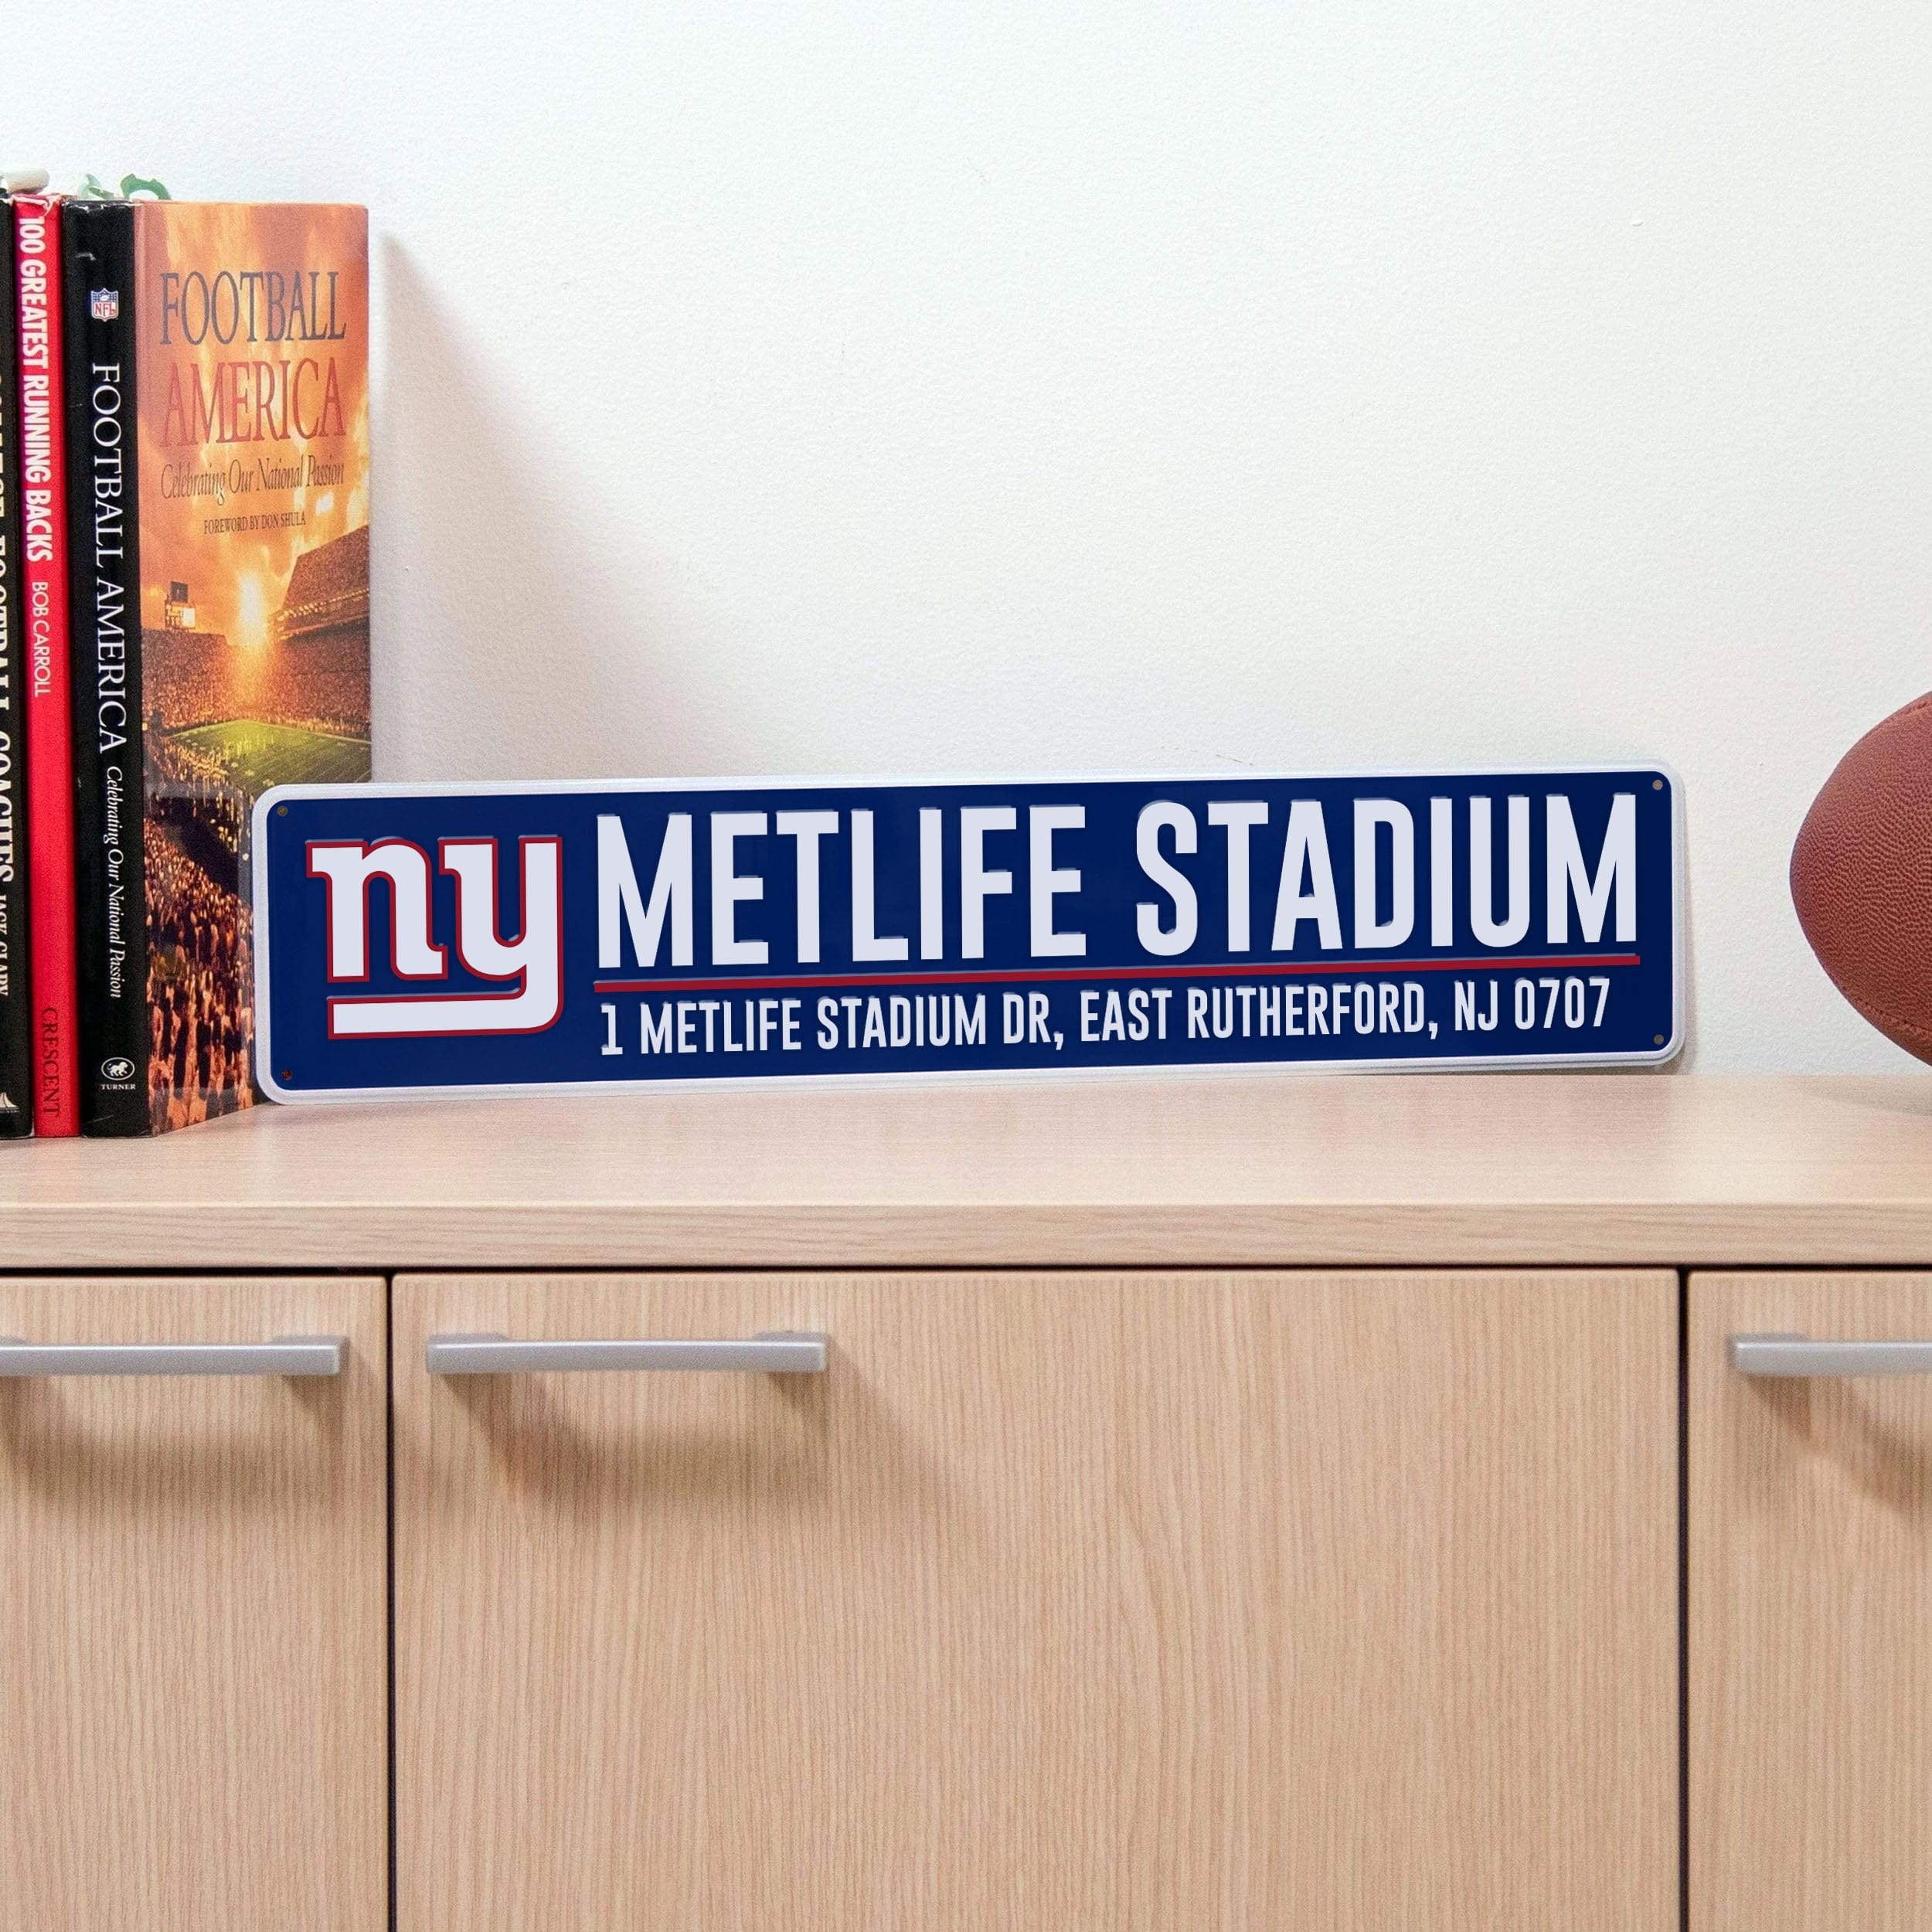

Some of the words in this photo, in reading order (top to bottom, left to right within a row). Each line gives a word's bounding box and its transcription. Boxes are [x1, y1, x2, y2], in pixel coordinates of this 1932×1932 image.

[19, 217, 45, 253] 100
[20, 260, 49, 369] GREATEST
[160, 270, 346, 345] FOOTBALL
[23, 375, 51, 483] RUNNING
[159, 356, 346, 448] AMERICA
[92, 362, 125, 568] FOOTBALL
[161, 461, 226, 505] Celebrating
[227, 458, 257, 494] Our
[257, 459, 304, 492] National
[306, 457, 345, 488] Passion
[26, 489, 53, 562] BACKS
[203, 517, 248, 535] FOREWORD
[249, 515, 260, 531] BY
[260, 514, 281, 530] DON
[281, 512, 307, 528] SHULA
[32, 581, 49, 617] BOB
[33, 620, 51, 698] CARROLL
[97, 577, 128, 754] AMERICA
[103, 766, 123, 845] Celebrating
[107, 849, 124, 880] Our
[597, 805, 1087, 968] METLIFE
[1135, 793, 1637, 956] STADIUM
[107, 883, 125, 945] National
[110, 948, 126, 998] Passion
[600, 1002, 623, 1056] 1
[639, 998, 802, 1055] METLIFE
[815, 992, 986, 1051] STADIUM
[1003, 992, 1065, 1050] DR,
[1080, 986, 1171, 1042] EAST
[1186, 980, 1439, 1040] RUTHERFORD,
[1454, 978, 1498, 1032] NJ
[1514, 976, 1611, 1029] 0707
[39, 1007, 60, 1117] CRESCENT
